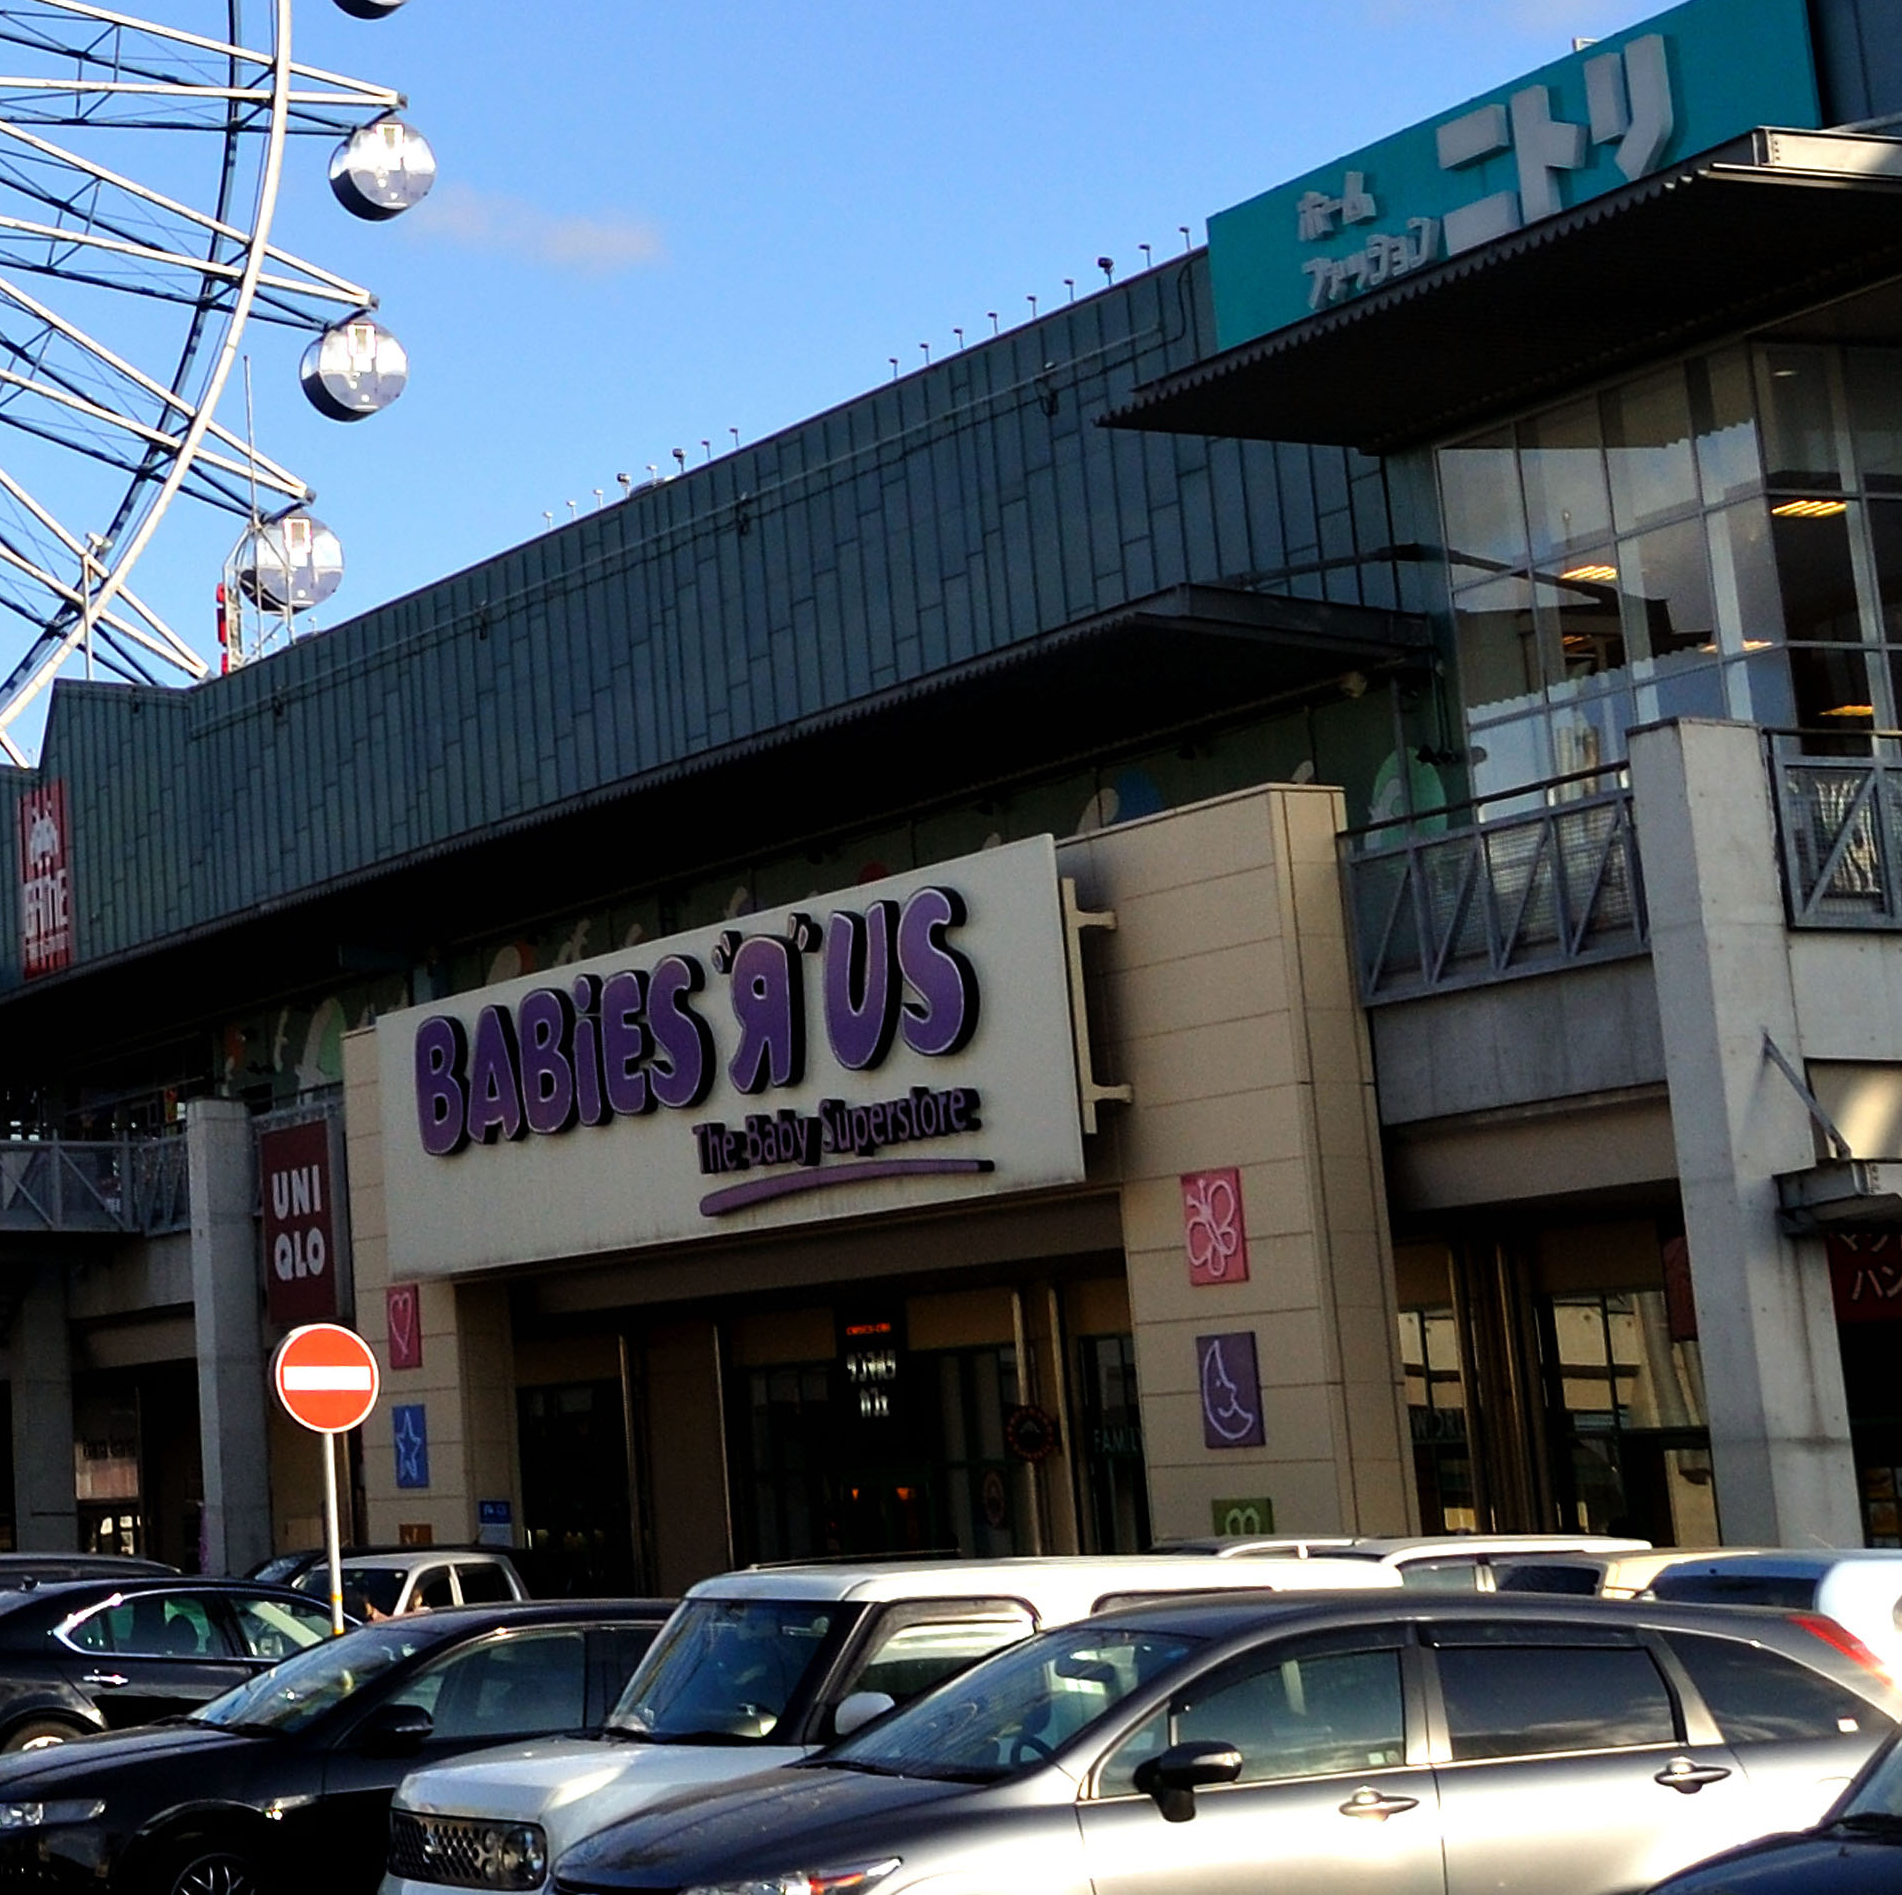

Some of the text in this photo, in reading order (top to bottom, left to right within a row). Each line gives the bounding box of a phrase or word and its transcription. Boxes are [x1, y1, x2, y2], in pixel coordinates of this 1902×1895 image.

[1436, 32, 1673, 257] ニトリ
[1297, 170, 1377, 242] ホーム
[822, 886, 981, 1070] US
[694, 1087, 979, 1175] The Baby Superstore
[272, 1164, 322, 1221] UNI
[274, 1227, 325, 1281] QLO
